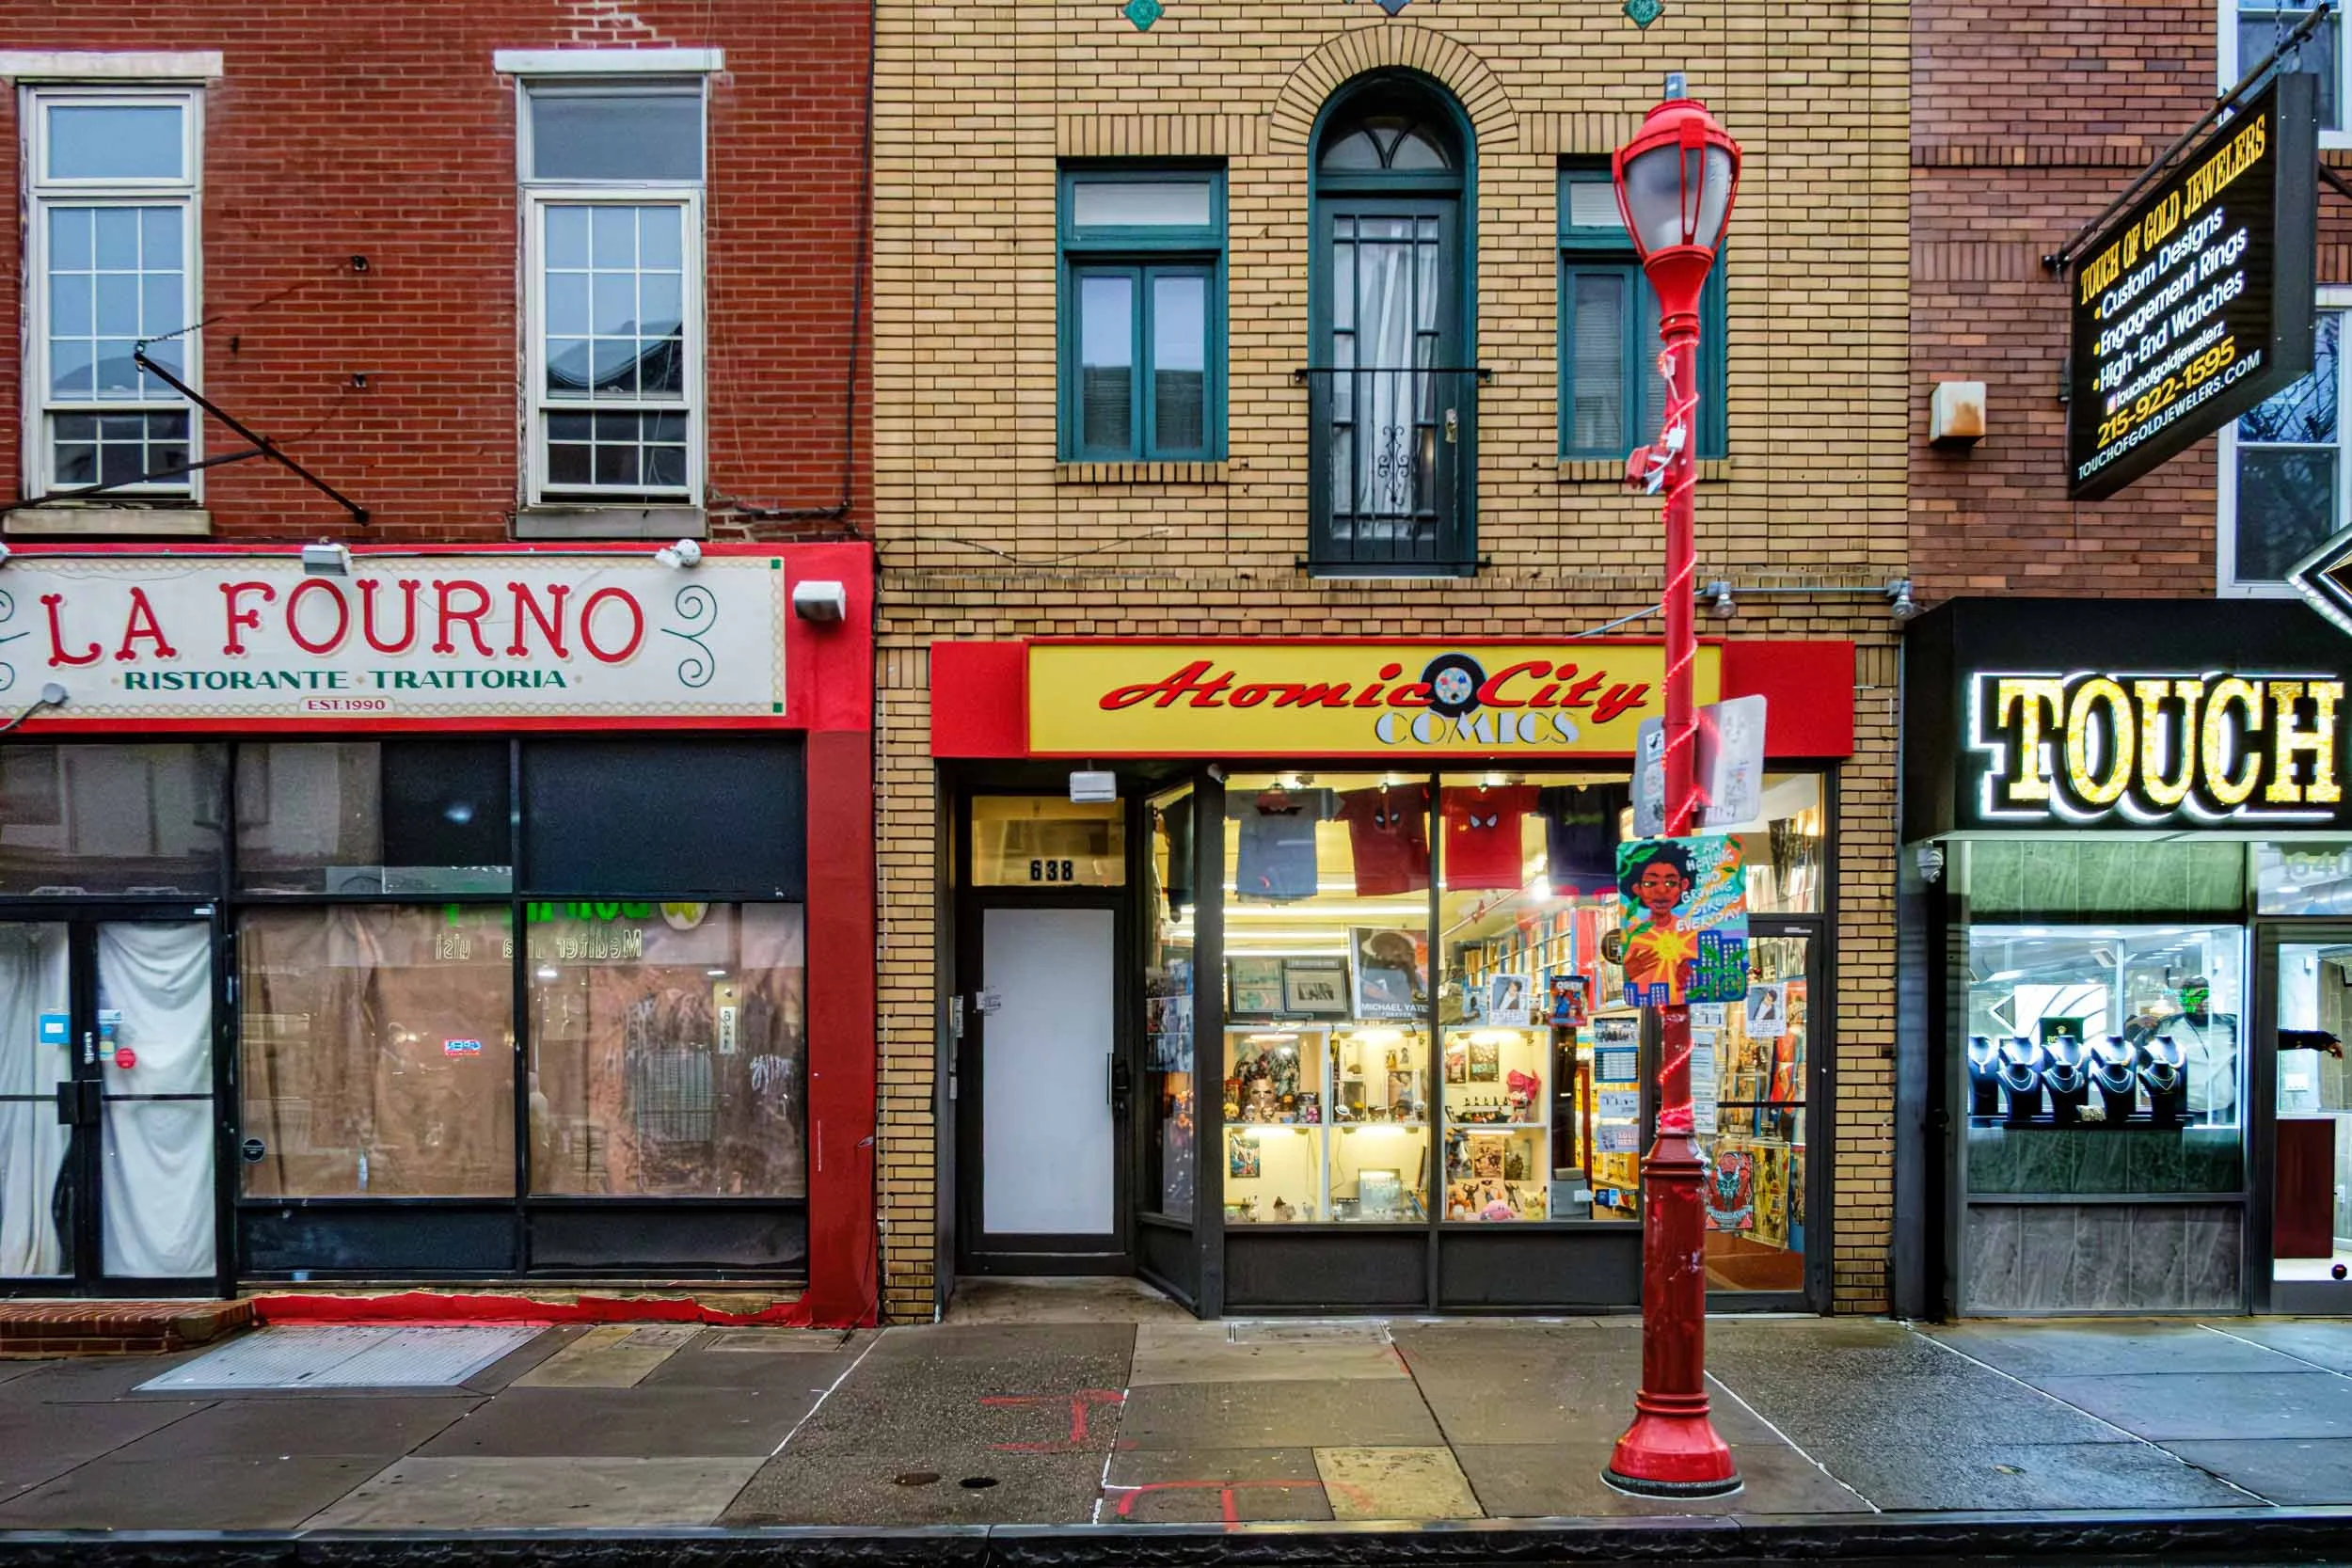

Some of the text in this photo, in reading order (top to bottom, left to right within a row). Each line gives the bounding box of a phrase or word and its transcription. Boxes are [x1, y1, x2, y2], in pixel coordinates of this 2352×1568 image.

[2080, 113, 2265, 305] TOUCH OF GOLD JEWELERS
[2100, 228, 2248, 357] Engagement Rings
[2102, 205, 2223, 320] Custom Designs
[2100, 270, 2245, 392] High-End Watches
[2078, 349, 2262, 481] TOUCHOFGOLDJEWELERS.COM
[2097, 335, 2235, 450] 215-922-1595
[40, 578, 644, 667] LA FOURNO
[124, 670, 567, 689] RISTORANTE TRATTORIA
[1099, 660, 1650, 723] Atomic City
[1375, 712, 1581, 744] COMICS
[1997, 676, 2344, 805] TOUCH
[1030, 860, 1074, 881] 638
[1681, 881, 1733, 903] GROWING
[1686, 849, 1734, 872] HEALING
[1696, 871, 1720, 885] AND
[1361, 1003, 1402, 1012] MICHAEL
